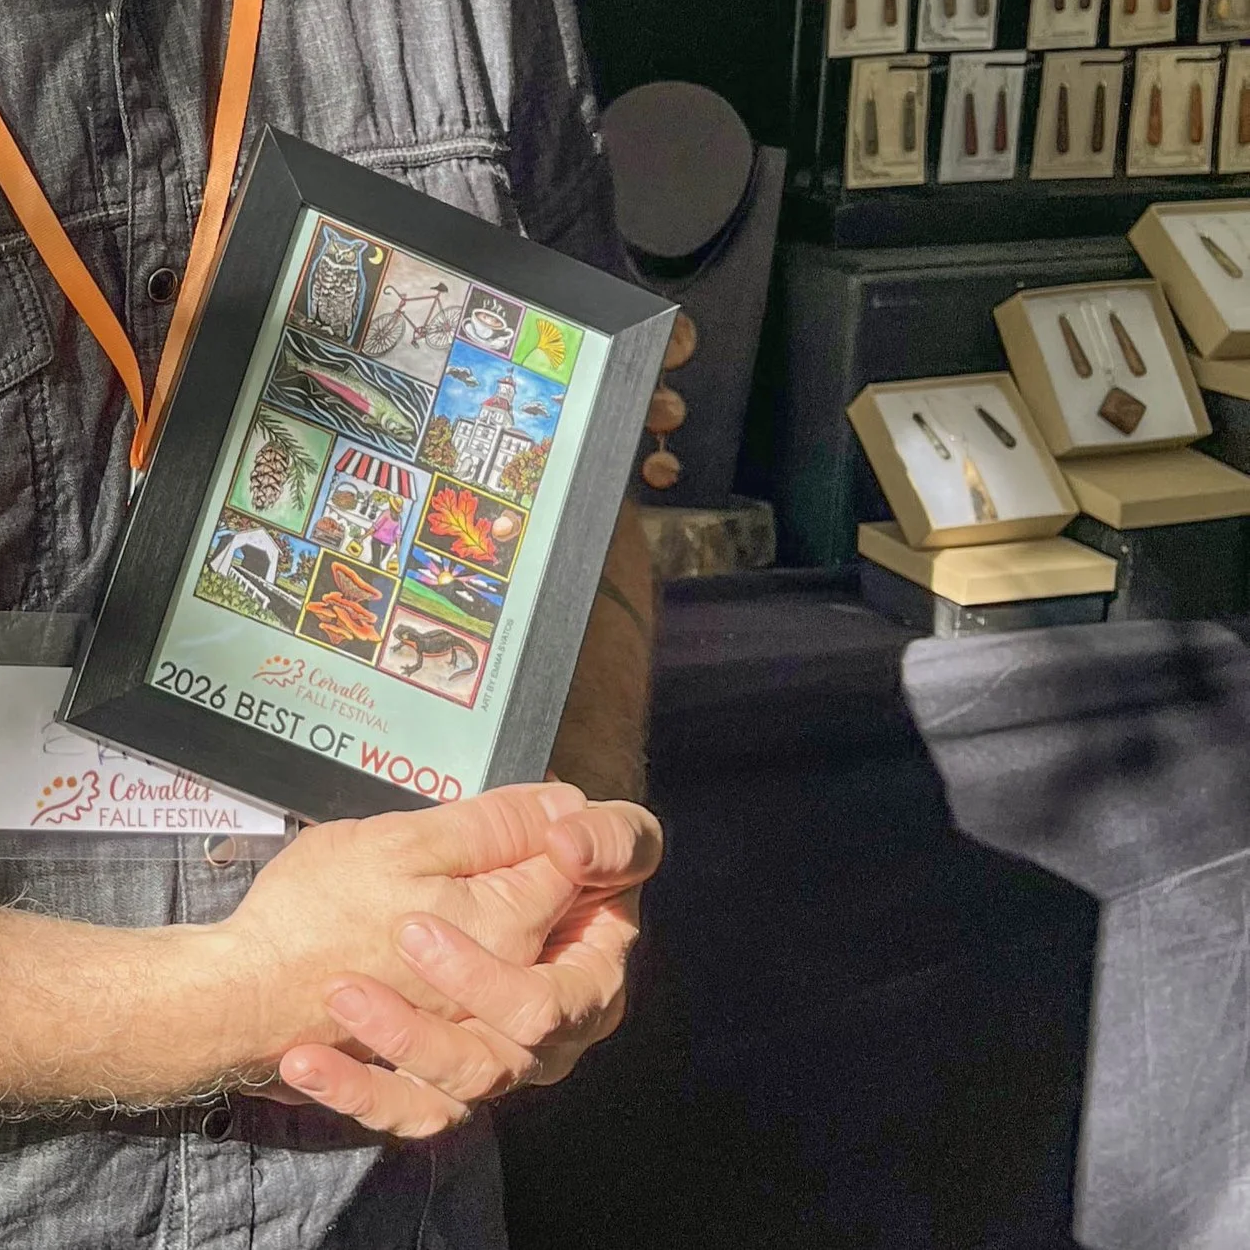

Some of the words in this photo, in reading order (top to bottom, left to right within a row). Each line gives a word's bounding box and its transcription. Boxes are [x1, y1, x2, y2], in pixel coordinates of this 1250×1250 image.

[498, 618, 515, 652] SVATOS
[490, 653, 503, 680] EMMA
[308, 667, 375, 709] Corvallis
[480, 692, 492, 712] ART
[485, 680, 496, 693] BY
[295, 685, 328, 711] FALL
[330, 698, 390, 735] FESTIVAL
[154, 660, 228, 710] 2026
[233, 690, 306, 740] BEST
[309, 723, 356, 758] OF
[361, 740, 463, 803] WOOD
[109, 771, 211, 803] Corvallis
[99, 807, 148, 828] FALL
[153, 807, 243, 829] FESTIVAL
